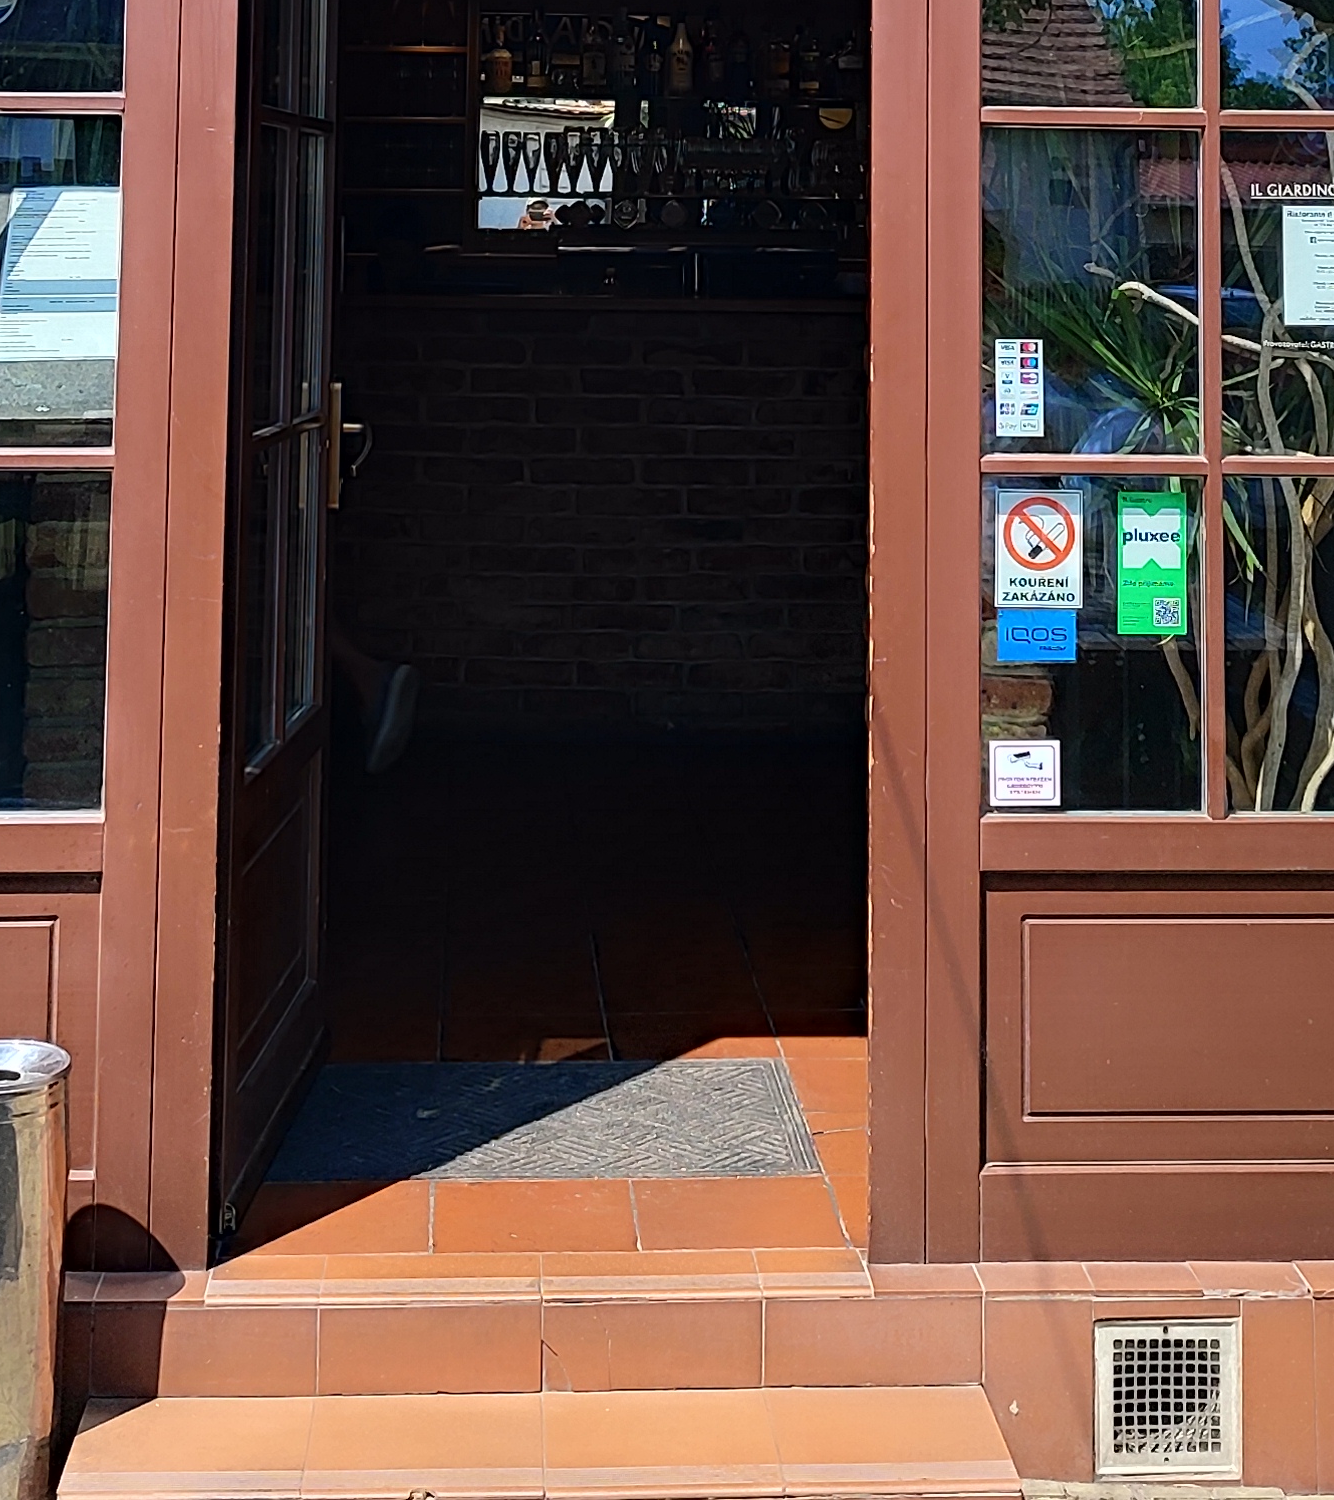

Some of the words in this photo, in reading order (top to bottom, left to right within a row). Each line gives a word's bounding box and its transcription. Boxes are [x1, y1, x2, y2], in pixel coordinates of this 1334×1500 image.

[1250, 183, 1263, 197] IL
[1122, 528, 1181, 546] pluxee
[1009, 575, 1070, 588] KOUŘENÍ
[1002, 589, 1076, 602] ZAKÁZÁNO
[1005, 627, 1068, 645] IQOS
